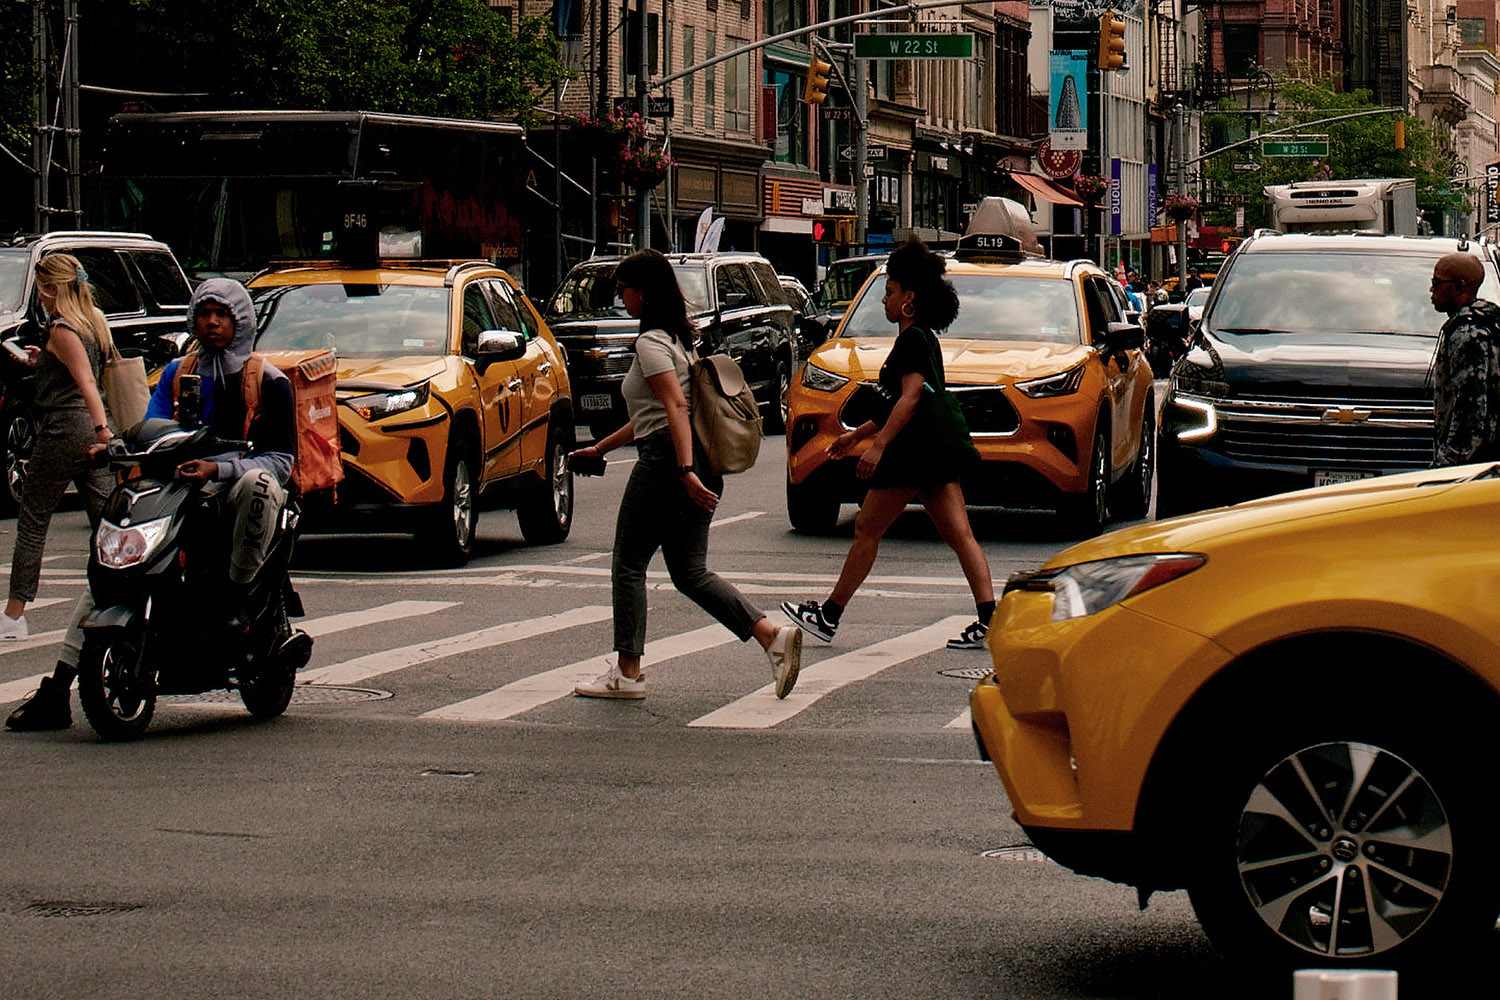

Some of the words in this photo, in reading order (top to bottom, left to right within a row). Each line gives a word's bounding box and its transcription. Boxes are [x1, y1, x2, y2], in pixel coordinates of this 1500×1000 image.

[889, 41, 900, 54] W
[904, 40, 920, 54] 22
[925, 40, 938, 53] St
[1283, 145, 1289, 153] W
[976, 237, 1003, 247] 5L19
[247, 472, 272, 530] urley
